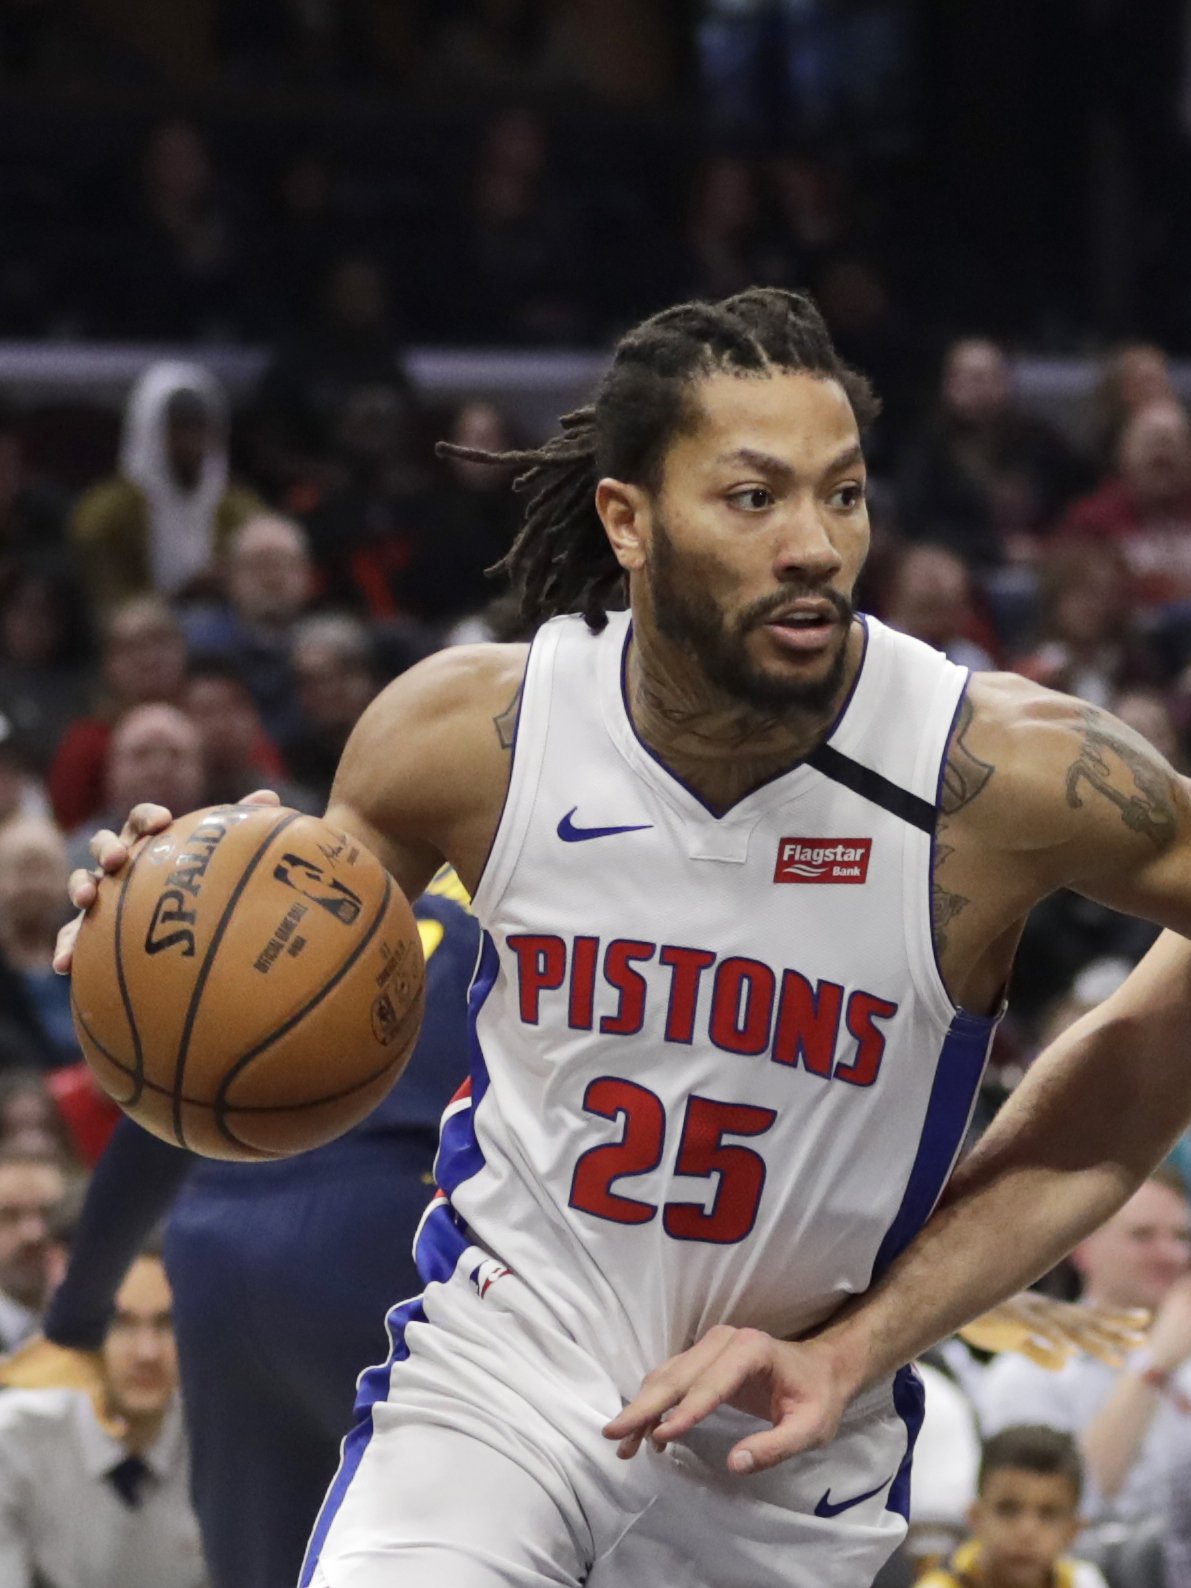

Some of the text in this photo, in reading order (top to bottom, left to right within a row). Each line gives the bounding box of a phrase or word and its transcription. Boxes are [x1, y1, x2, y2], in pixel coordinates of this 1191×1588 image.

[145, 808, 250, 957] SPALD
[783, 844, 865, 865] Flagstar
[832, 866, 861, 876] Bank
[505, 933, 898, 1088] PISTONS
[568, 1075, 777, 1245] 25
